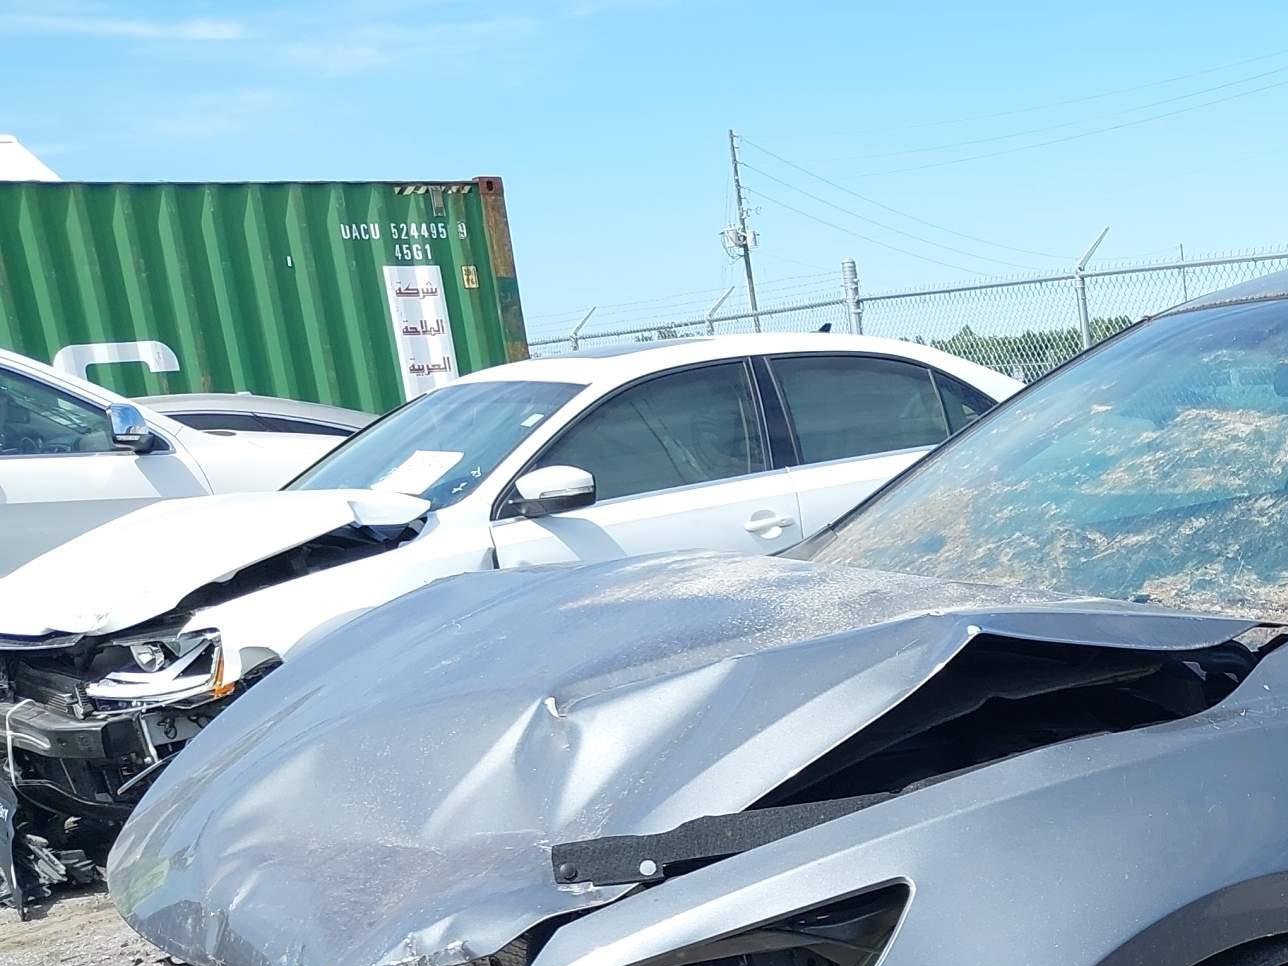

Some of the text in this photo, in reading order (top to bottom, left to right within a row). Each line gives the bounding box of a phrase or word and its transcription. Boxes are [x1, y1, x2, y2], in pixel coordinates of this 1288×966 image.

[340, 221, 468, 240] UACU 524495 9
[395, 244, 432, 260] 45G1
[395, 281, 438, 300] شركة
[402, 319, 446, 336] الملاحة
[409, 356, 452, 377] العربية
